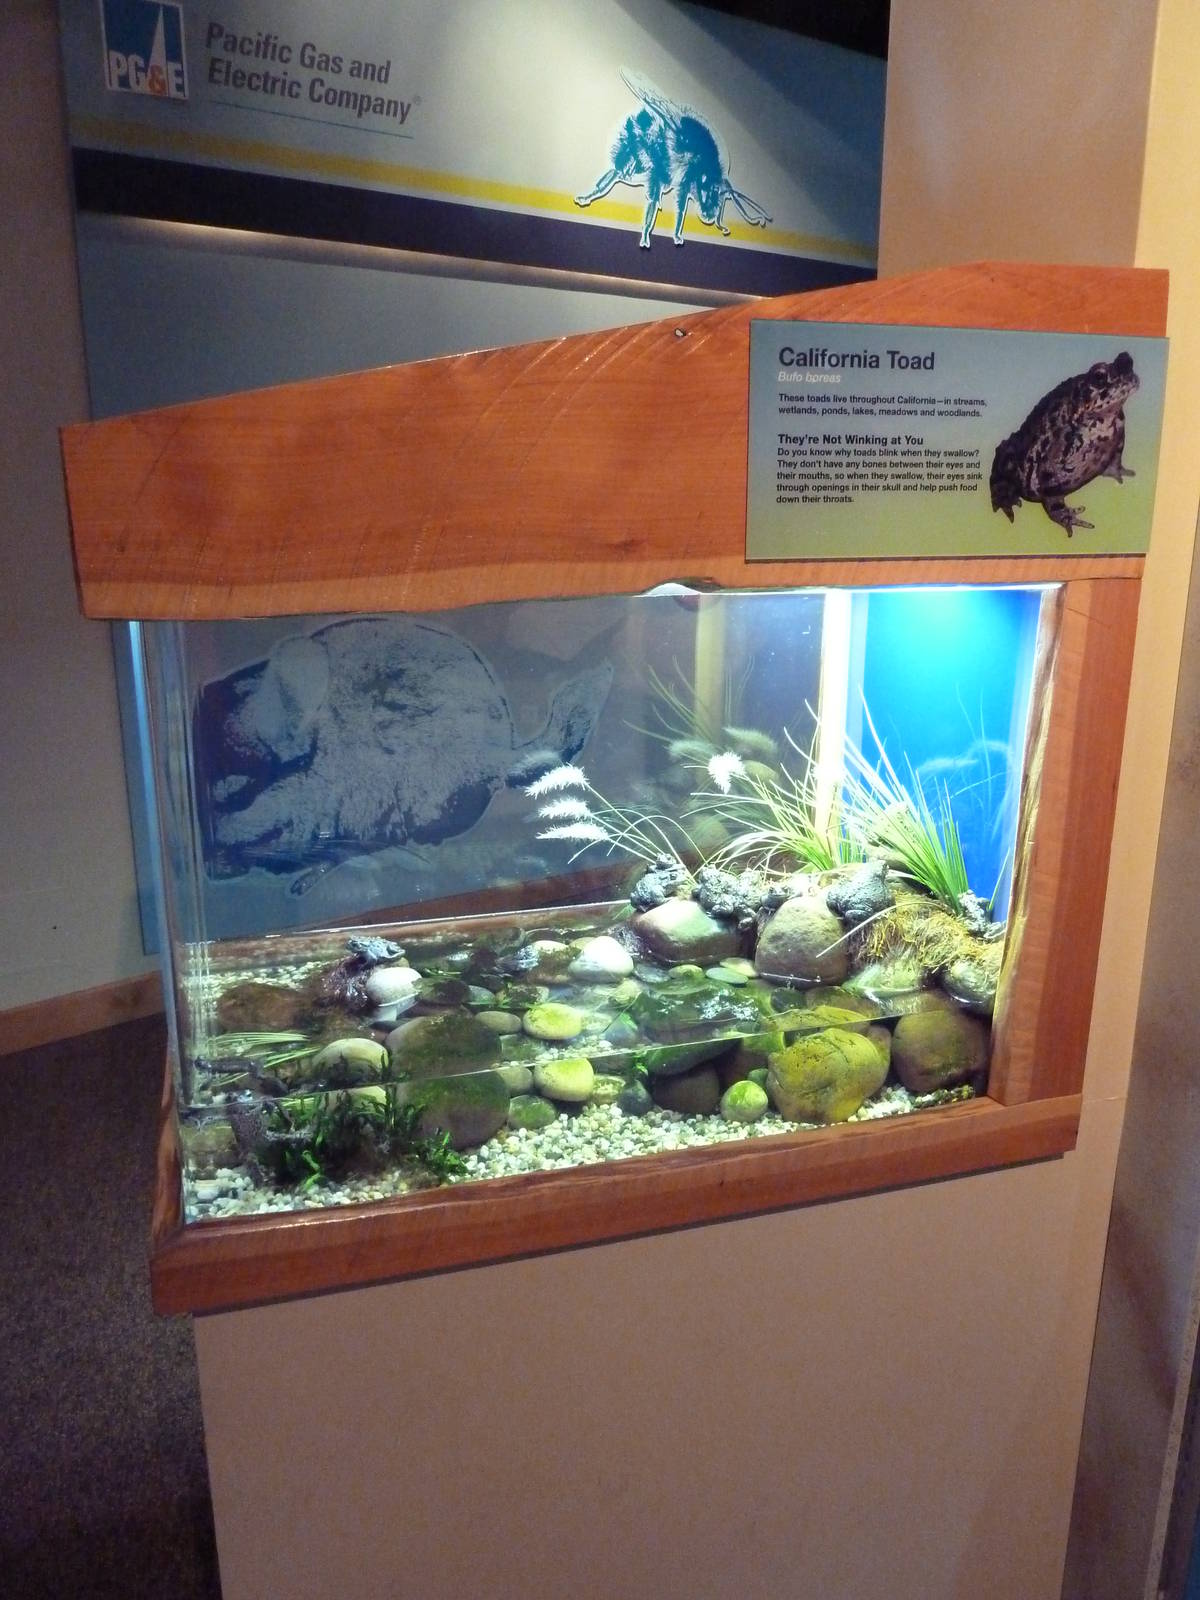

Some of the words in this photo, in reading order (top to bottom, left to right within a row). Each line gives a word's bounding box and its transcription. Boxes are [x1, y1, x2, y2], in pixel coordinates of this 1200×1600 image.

[206, 22, 292, 64] Pacific
[300, 42, 344, 74] Gas
[349, 57, 391, 84] and
[108, 52, 186, 96] PG&E
[208, 58, 302, 99] Electric
[308, 78, 412, 124] Company
[779, 347, 880, 369] California
[887, 350, 935, 370] Toad
[778, 372, 803, 383] Bufo
[779, 394, 804, 402] These
[807, 395, 831, 403] toads
[833, 395, 847, 403] live
[850, 395, 895, 405] throughout
[954, 398, 987, 407] streams,
[779, 406, 819, 415] wetlands,
[821, 408, 850, 416] ponds,
[852, 408, 877, 416] lakes,
[879, 408, 918, 416] meadows
[920, 408, 935, 416] and
[938, 409, 982, 417] woodlands.
[823, 435, 842, 444] Not
[845, 435, 887, 446] Winking
[891, 436, 901, 445] at
[905, 436, 923, 445] You
[778, 448, 790, 456] Do
[792, 450, 808, 458] you
[835, 449, 851, 458] why
[901, 449, 922, 457] when
[924, 449, 941, 458] they
[943, 449, 979, 457] swallow?
[777, 460, 798, 470] They
[824, 460, 843, 468] have
[845, 462, 860, 470] any
[862, 460, 887, 468] bones
[889, 460, 923, 468] between
[926, 460, 944, 468] their
[946, 462, 964, 470] eyes
[799, 472, 832, 481] mouths,
[871, 472, 889, 481] they
[891, 472, 925, 481] swallow,
[927, 472, 945, 480] their
[967, 472, 982, 480] sink
[777, 484, 810, 493] through
[812, 484, 849, 493] openings
[920, 484, 936, 493] help
[938, 484, 958, 493] push
[776, 495, 800, 503] down
[802, 495, 821, 503] their
[823, 495, 854, 503] throats.
